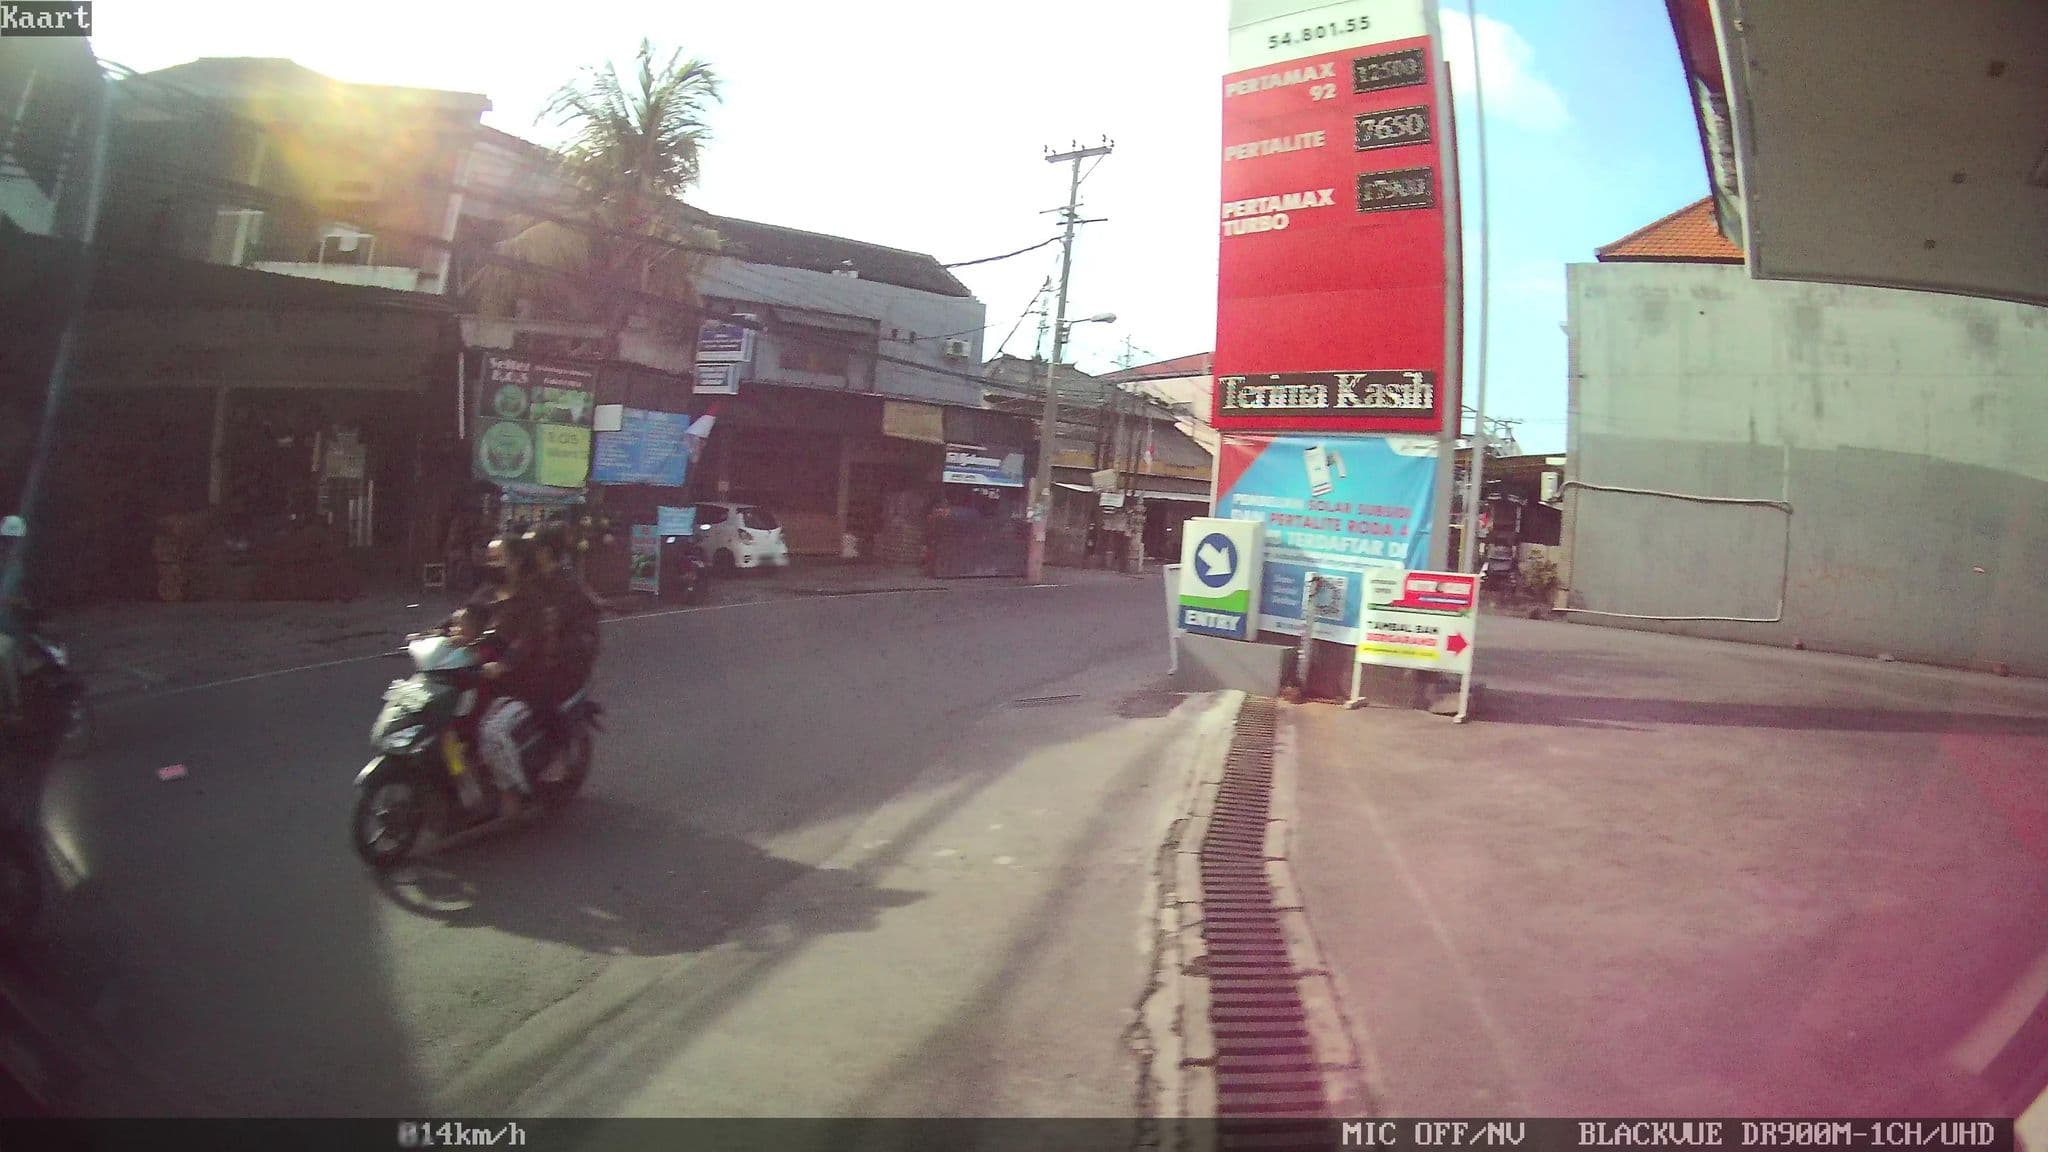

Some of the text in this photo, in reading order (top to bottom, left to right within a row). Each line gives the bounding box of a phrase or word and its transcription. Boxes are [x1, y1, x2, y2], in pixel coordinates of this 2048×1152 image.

[1267, 16, 1371, 49] 54.801.55
[1226, 62, 1337, 98] PERTAMAX
[1309, 83, 1337, 102] 92
[1360, 113, 1426, 140] 7650
[1225, 130, 1327, 161] PERTALITE
[1222, 188, 1336, 218] PERTAMAX
[1222, 213, 1291, 236] TURBO
[1218, 371, 1433, 409] Terima Kasih
[1308, 499, 1352, 513] SOLAR
[1270, 513, 1341, 532] PERTALITE
[1347, 520, 1393, 536] RODA
[1185, 610, 1241, 631] ENTRY
